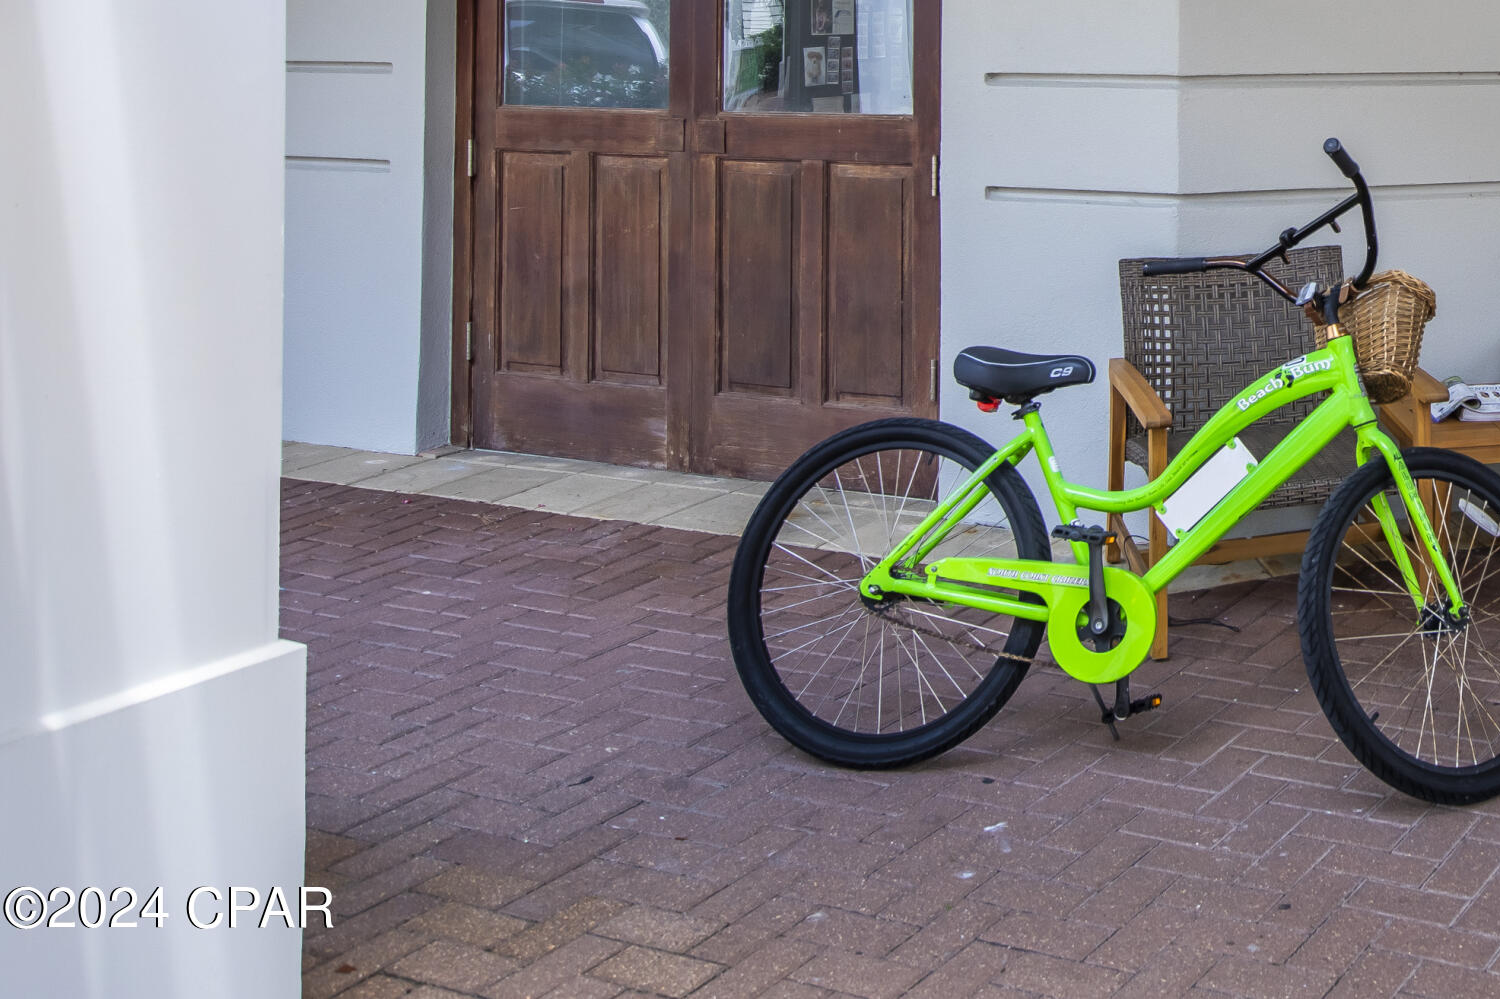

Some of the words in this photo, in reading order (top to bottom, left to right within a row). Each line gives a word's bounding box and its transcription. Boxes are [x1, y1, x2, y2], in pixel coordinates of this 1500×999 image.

[1050, 366, 1074, 378] C9
[1236, 377, 1285, 411] Beach
[1290, 354, 1334, 379] Bum
